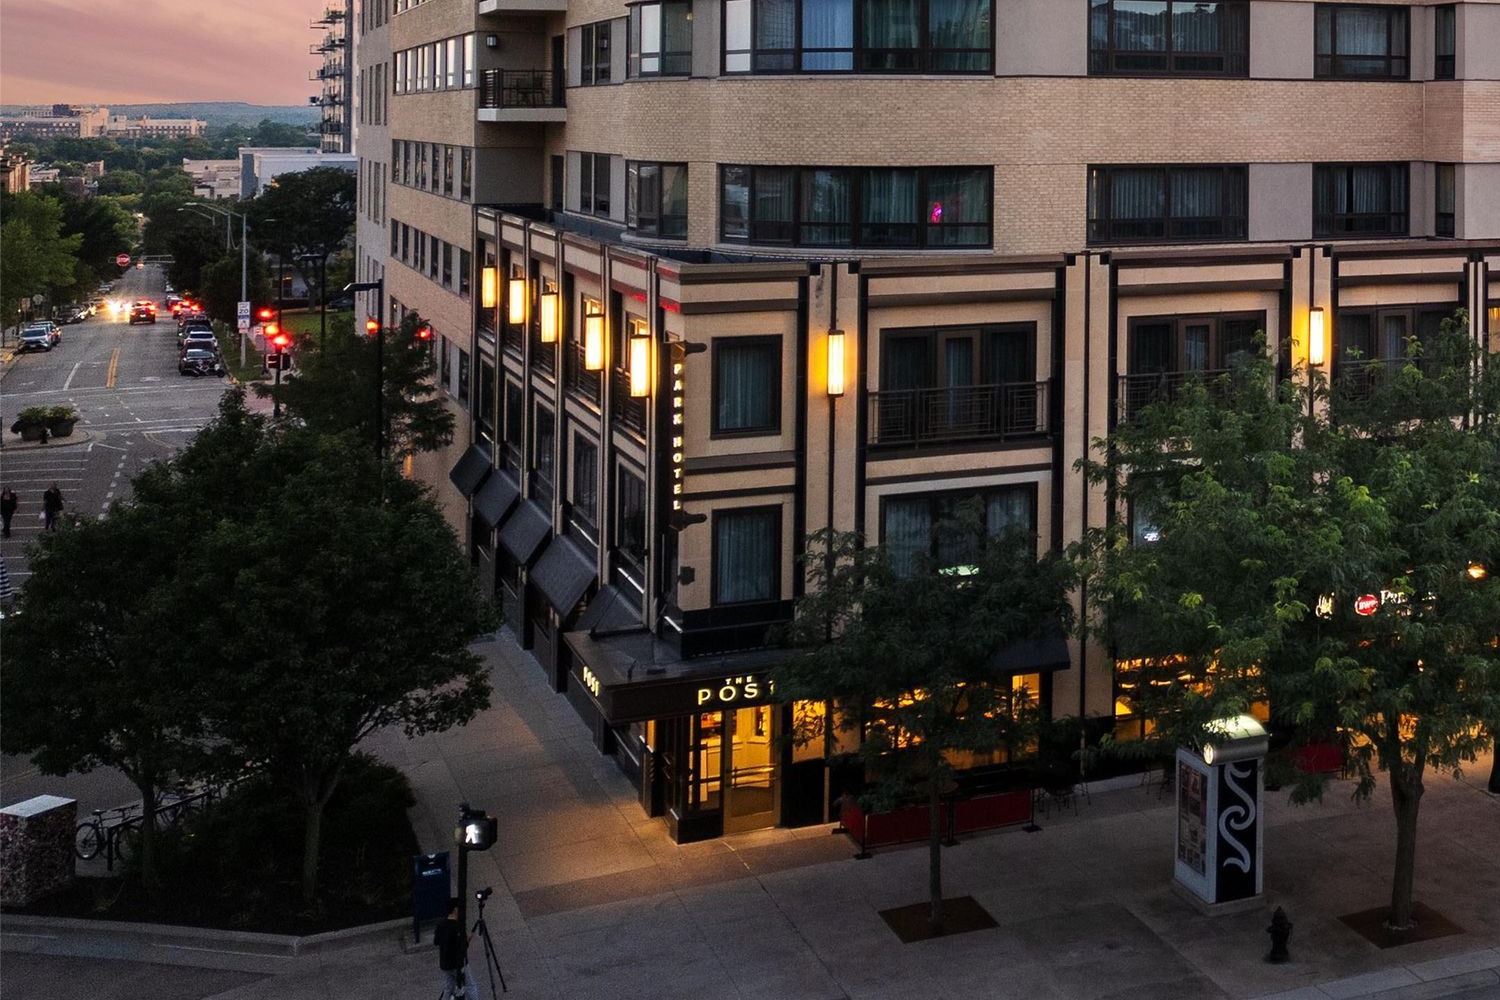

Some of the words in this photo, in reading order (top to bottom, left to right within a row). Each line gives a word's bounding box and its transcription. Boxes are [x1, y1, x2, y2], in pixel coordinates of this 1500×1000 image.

[672, 363, 683, 425] PARK
[672, 436, 683, 511] HOTEL
[583, 666, 600, 697] POST
[725, 675, 753, 685] THE
